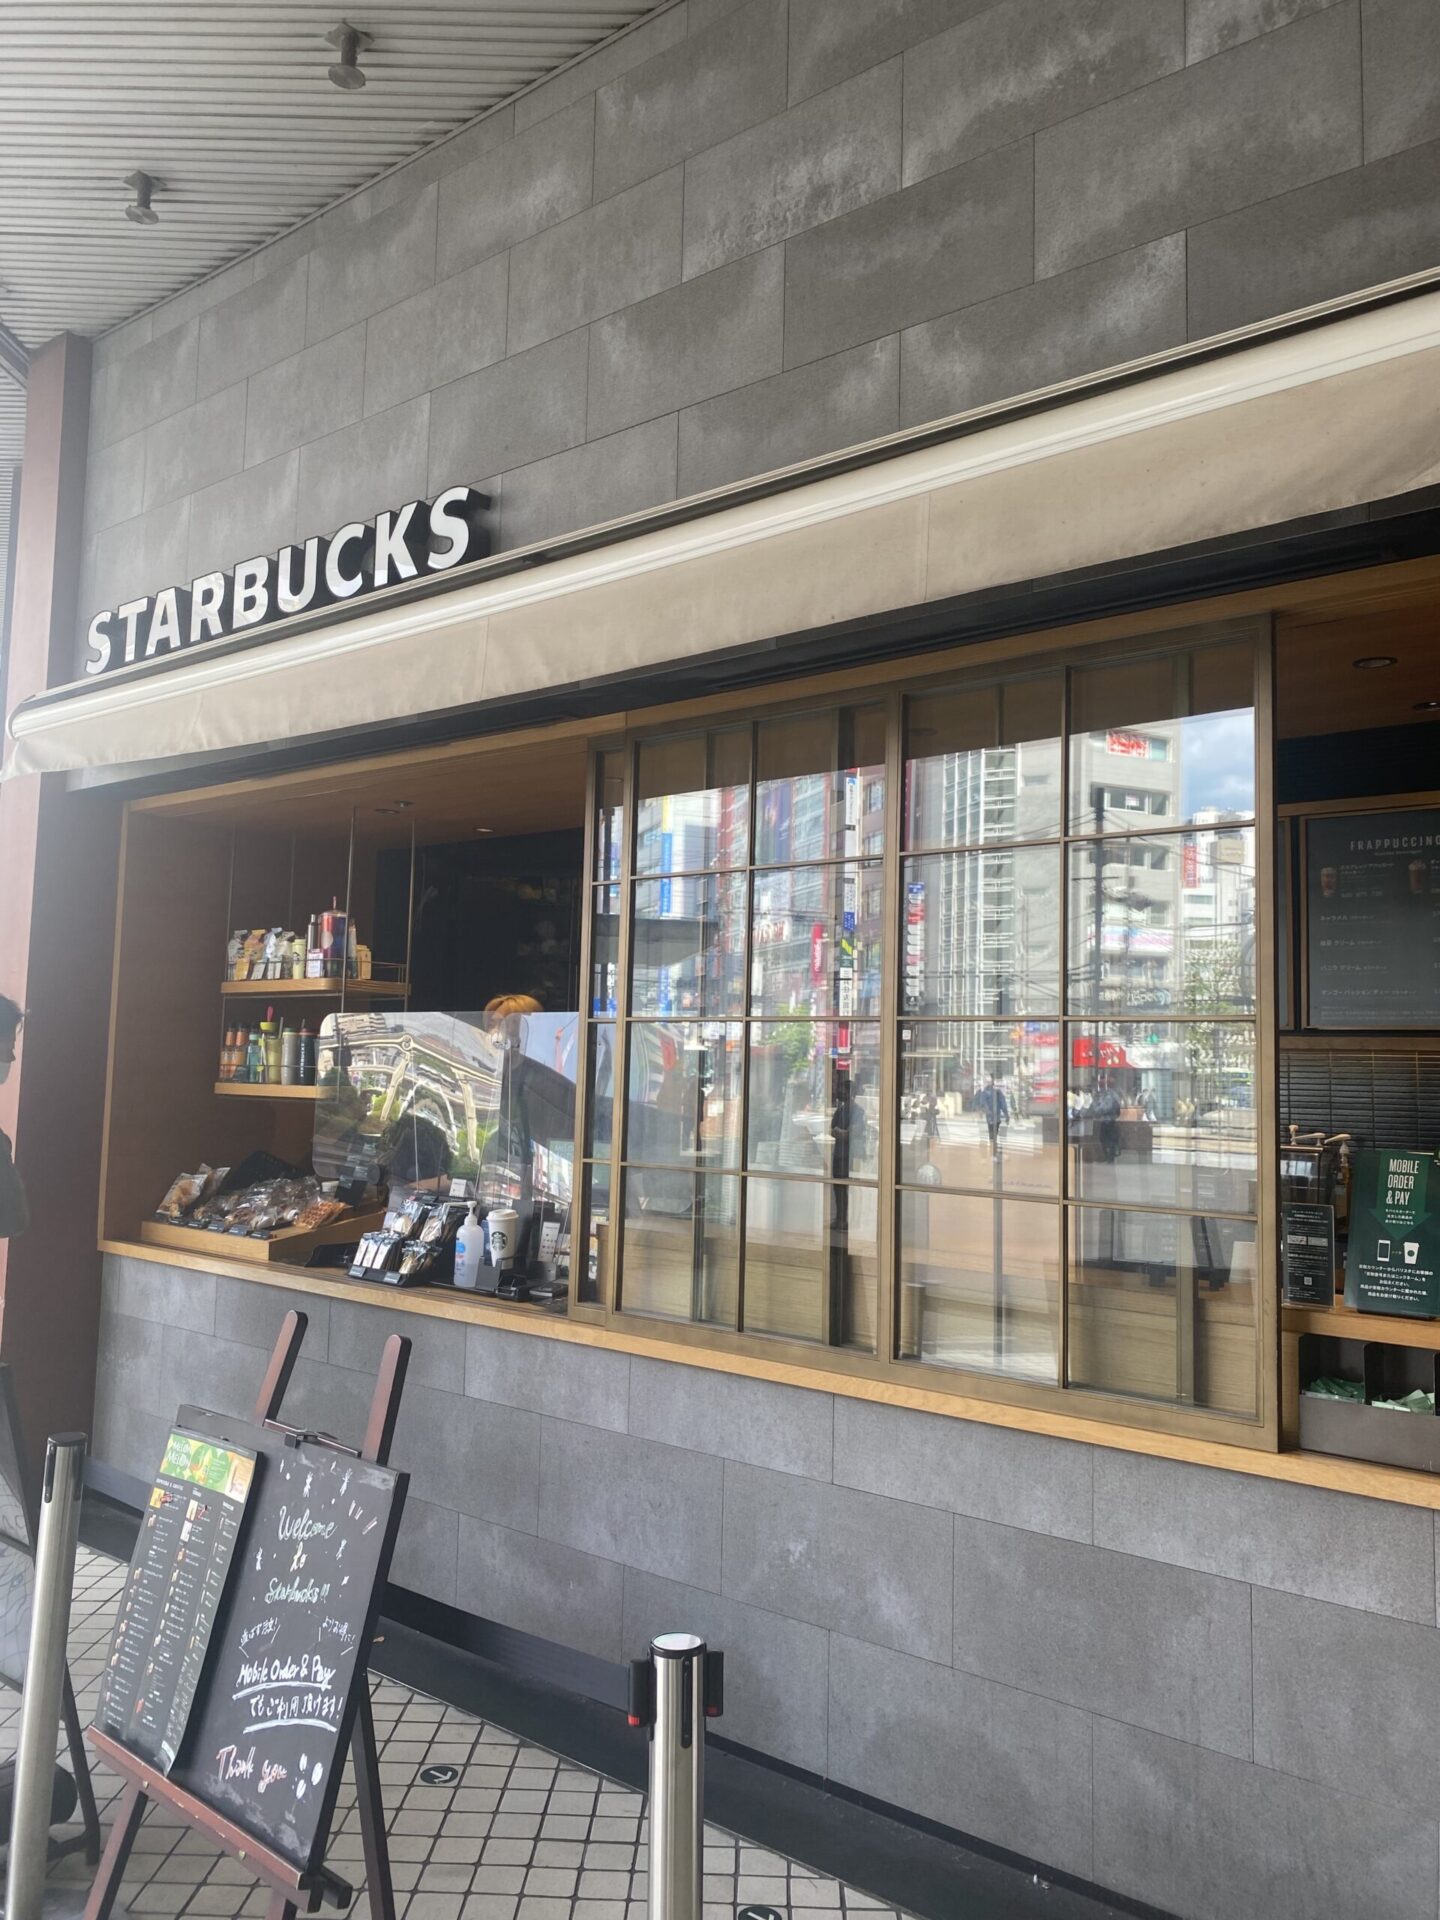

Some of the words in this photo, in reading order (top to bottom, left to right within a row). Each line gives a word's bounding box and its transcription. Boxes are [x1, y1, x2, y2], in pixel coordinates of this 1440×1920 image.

[85, 486, 474, 675] STARBUCKS
[1387, 1174, 1415, 1190] ORDER
[1389, 1158, 1420, 1174] MOBILE
[1385, 1190, 1394, 1205] &
[1394, 1190, 1411, 1206] PAY
[278, 1505, 337, 1540] Welcome
[290, 1541, 308, 1571] to
[236, 1657, 269, 1687] Mobile
[270, 1656, 300, 1680] Order
[300, 1654, 309, 1678] &
[311, 1654, 336, 1692] Pay
[216, 1744, 256, 1781] Thank
[258, 1759, 288, 1793] you
